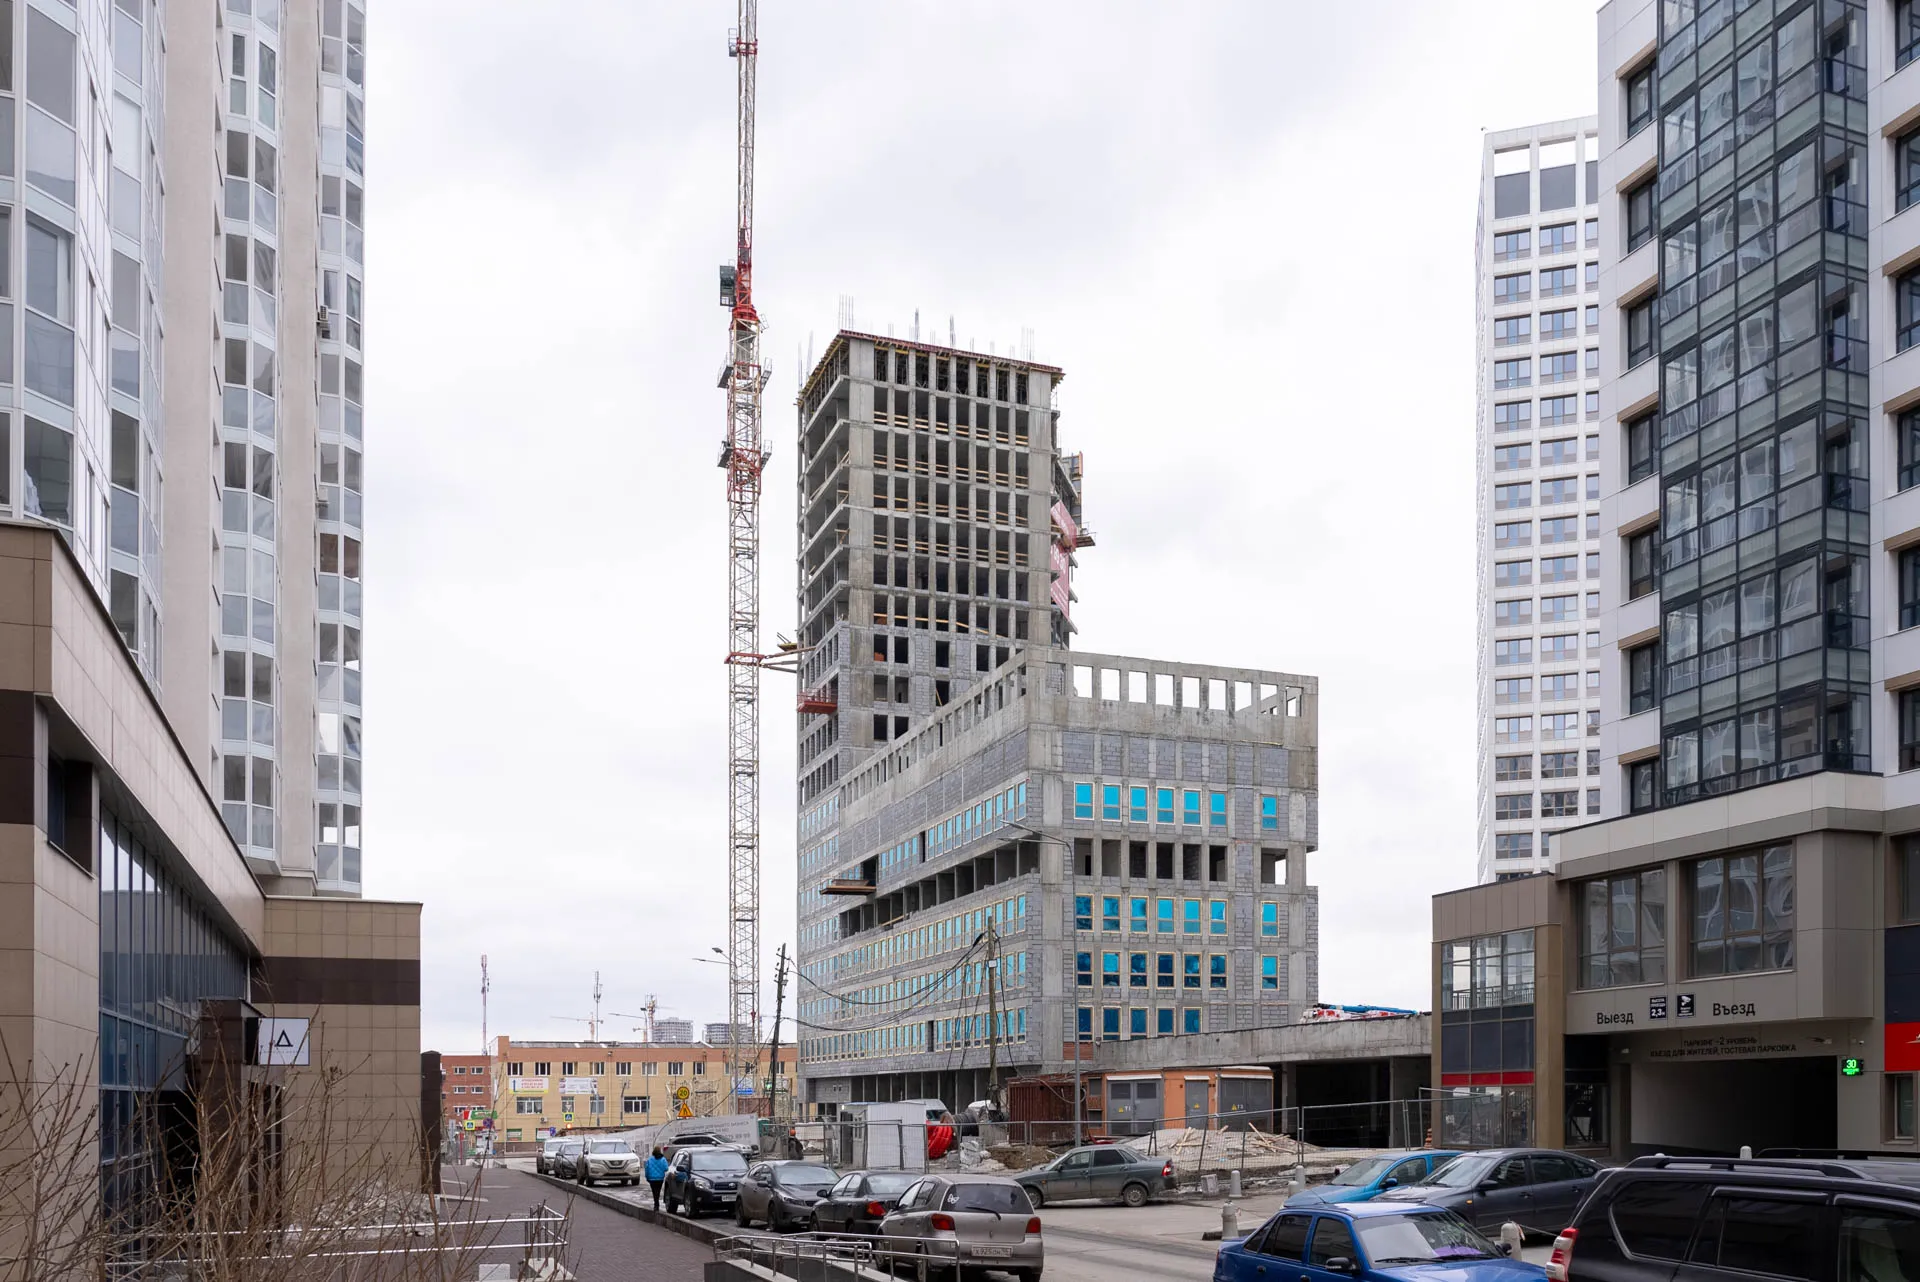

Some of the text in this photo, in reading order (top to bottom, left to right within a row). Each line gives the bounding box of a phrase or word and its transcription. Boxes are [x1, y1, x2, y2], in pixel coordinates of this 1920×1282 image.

[1713, 1003, 1755, 1016] Въезд
[1596, 1012, 1634, 1025] Выезд
[1683, 1039, 1713, 1047] ПАРКИНГ
[1726, 1036, 1757, 1045] УРОВЕНЬ
[1720, 1046, 1756, 1055] ГОСТЕВАЯ
[1757, 1043, 1797, 1053] ПАРКОВКА
[1846, 1059, 1857, 1069] 30
